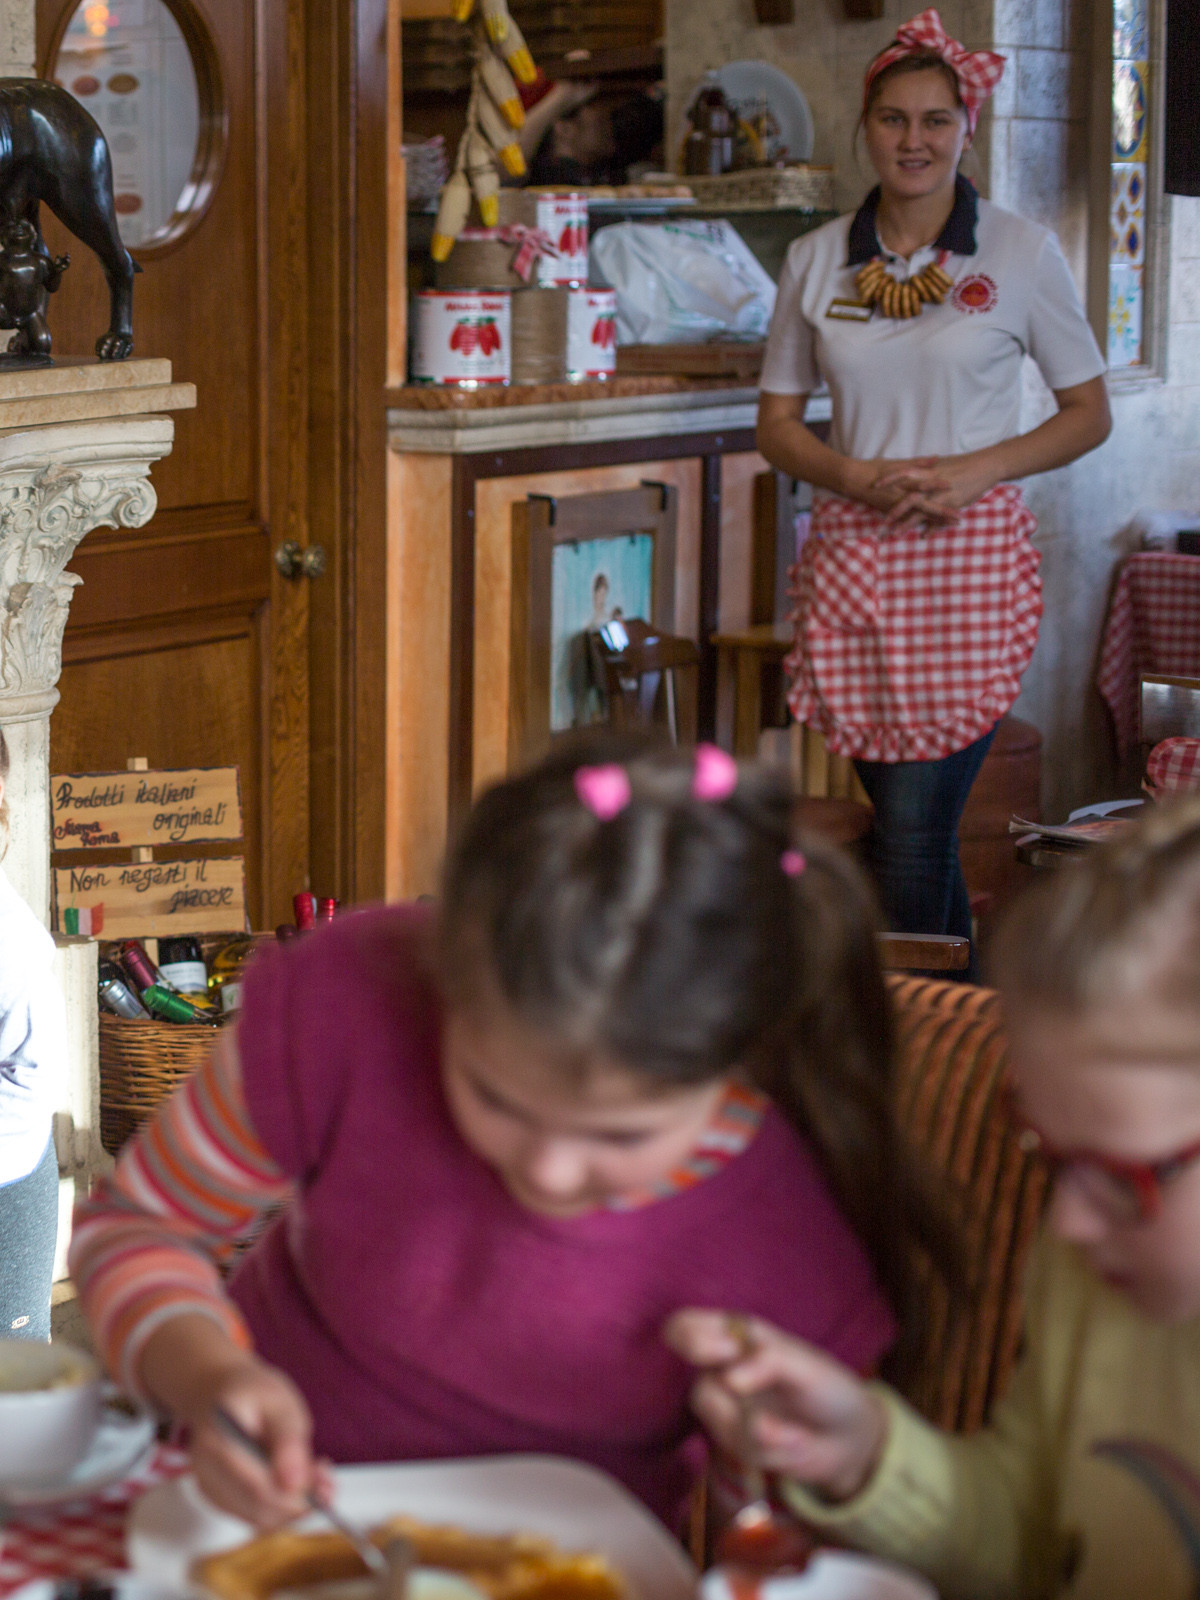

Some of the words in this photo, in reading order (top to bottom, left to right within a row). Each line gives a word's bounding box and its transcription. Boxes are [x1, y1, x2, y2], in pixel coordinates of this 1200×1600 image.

[56, 782, 125, 811] Prodotti
[135, 778, 197, 806] italiani
[153, 802, 228, 841] originali
[70, 868, 110, 893] Non
[196, 859, 207, 882] il
[168, 884, 234, 914] piacere
